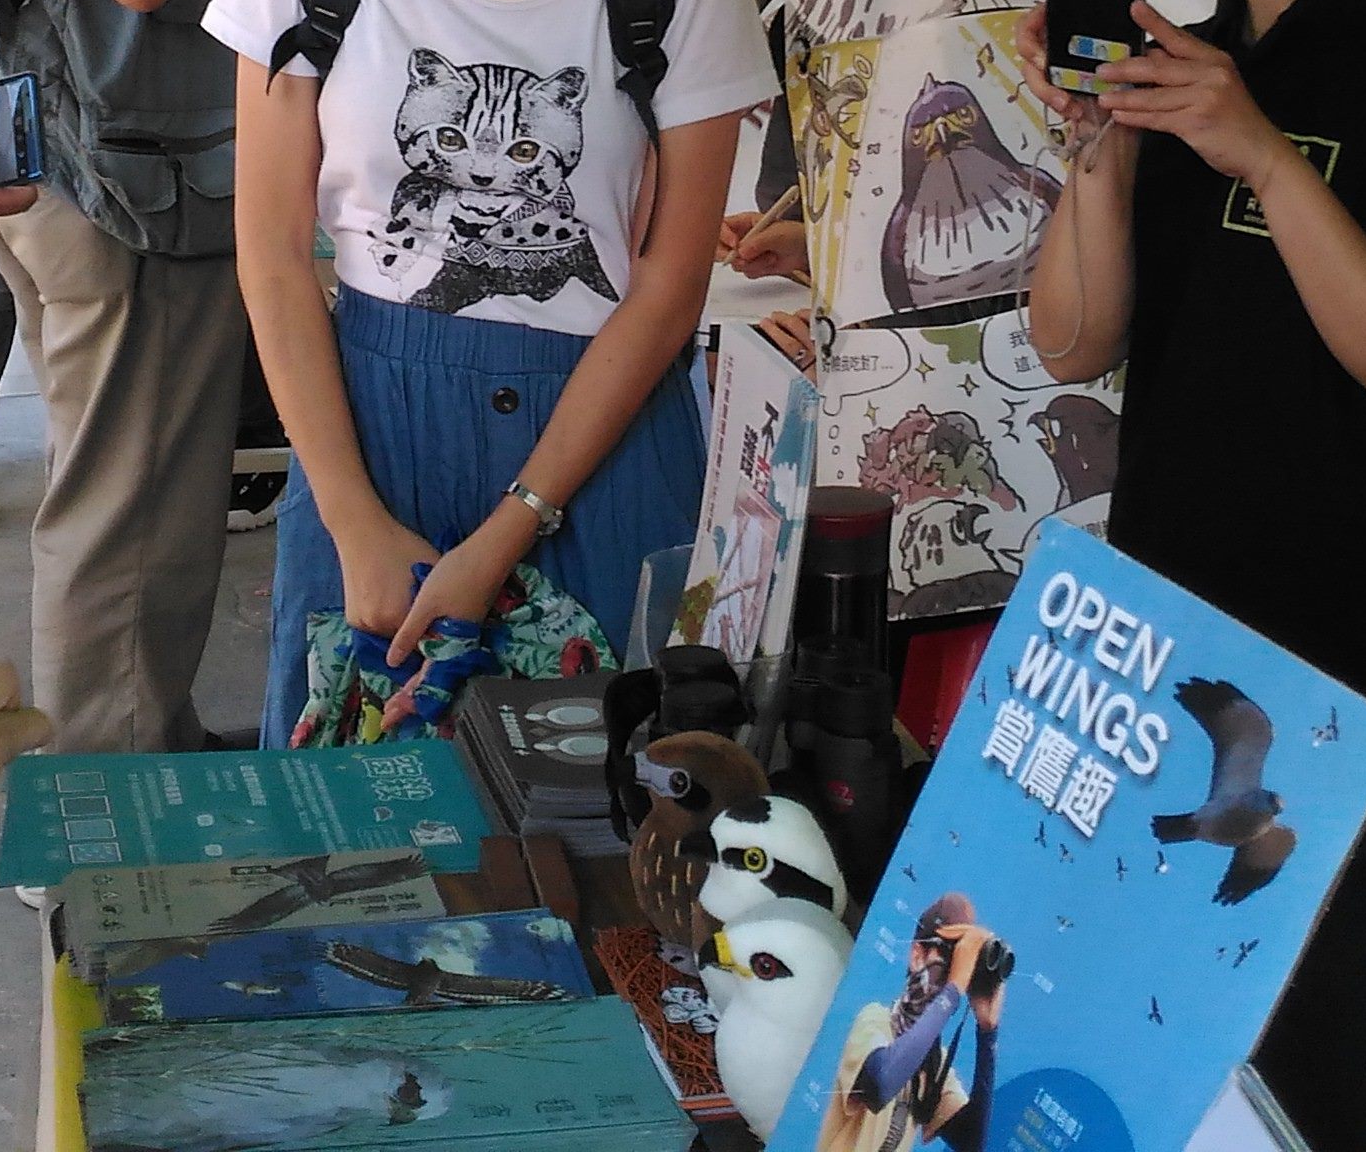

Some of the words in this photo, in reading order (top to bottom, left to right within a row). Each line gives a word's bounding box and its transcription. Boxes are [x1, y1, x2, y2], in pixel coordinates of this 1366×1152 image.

[1037, 570, 1175, 694] OPEN
[982, 697, 1118, 839] 賞鷹趣
[1012, 634, 1170, 777] WINGS
